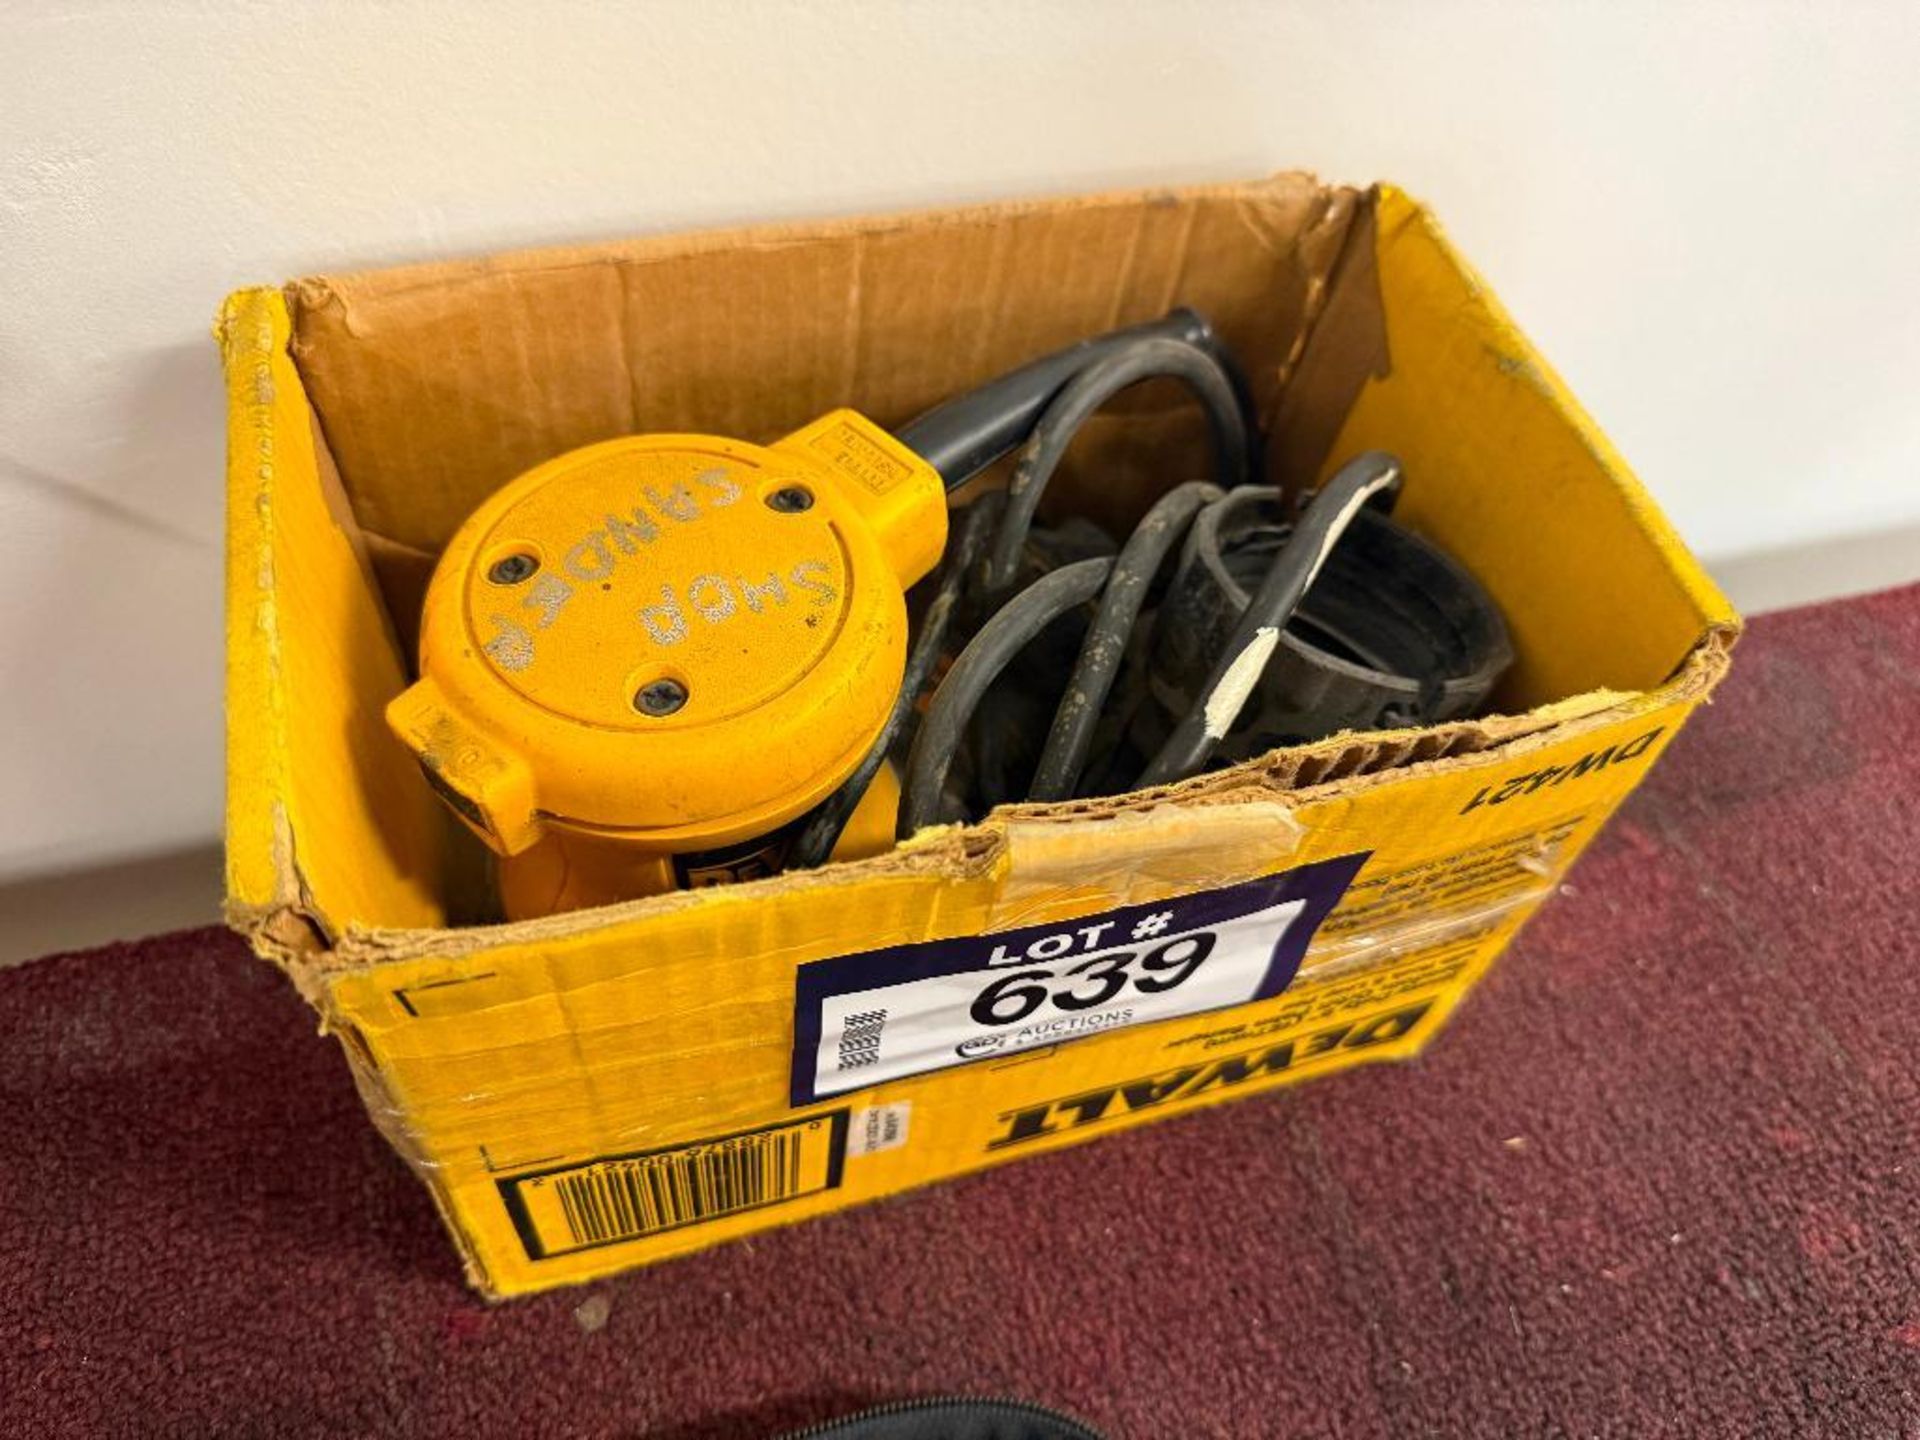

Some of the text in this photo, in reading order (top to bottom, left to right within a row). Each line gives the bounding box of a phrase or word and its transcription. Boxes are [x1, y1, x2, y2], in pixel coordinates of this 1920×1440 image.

[485, 467, 742, 672] SANDER
[638, 560, 837, 647] SHOP
[1459, 726, 1666, 815] DW421
[969, 931, 1218, 1027] 639
[988, 910, 1174, 966] LOT #
[1017, 1008, 1134, 1037] AUCTIONS
[986, 1001, 1435, 1152] DEWALT
